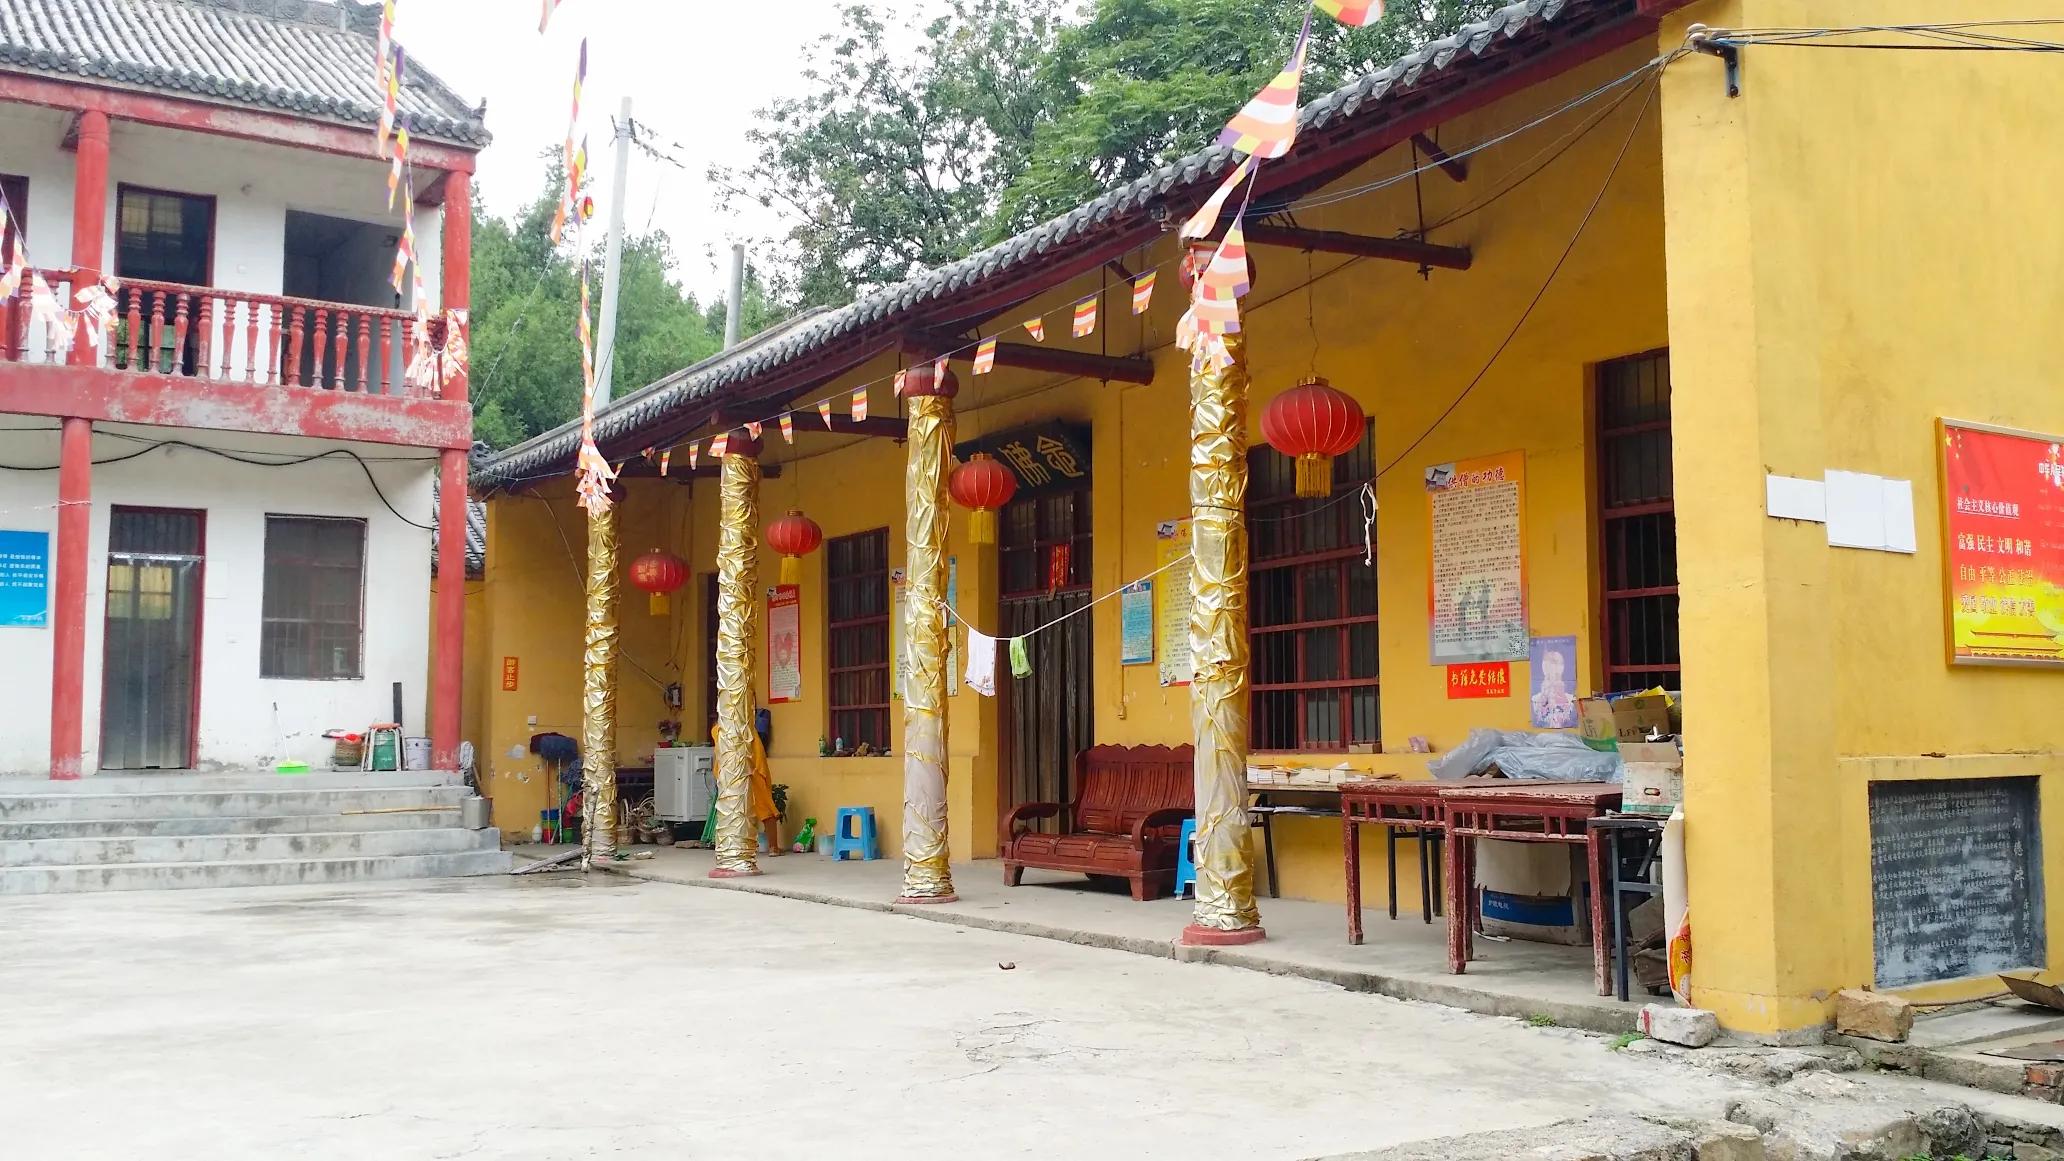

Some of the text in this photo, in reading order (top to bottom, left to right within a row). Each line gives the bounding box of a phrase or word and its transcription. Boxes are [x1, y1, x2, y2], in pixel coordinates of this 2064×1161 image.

[997, 435, 1084, 488] 念佛
[1446, 467, 1505, 488] 供僧的功德
[1957, 496, 2019, 517] 社会主义核心价值观
[1958, 532, 2032, 557] 富强 民主 文明 和谐
[1960, 564, 2033, 587] 自由 平等 公正 法治
